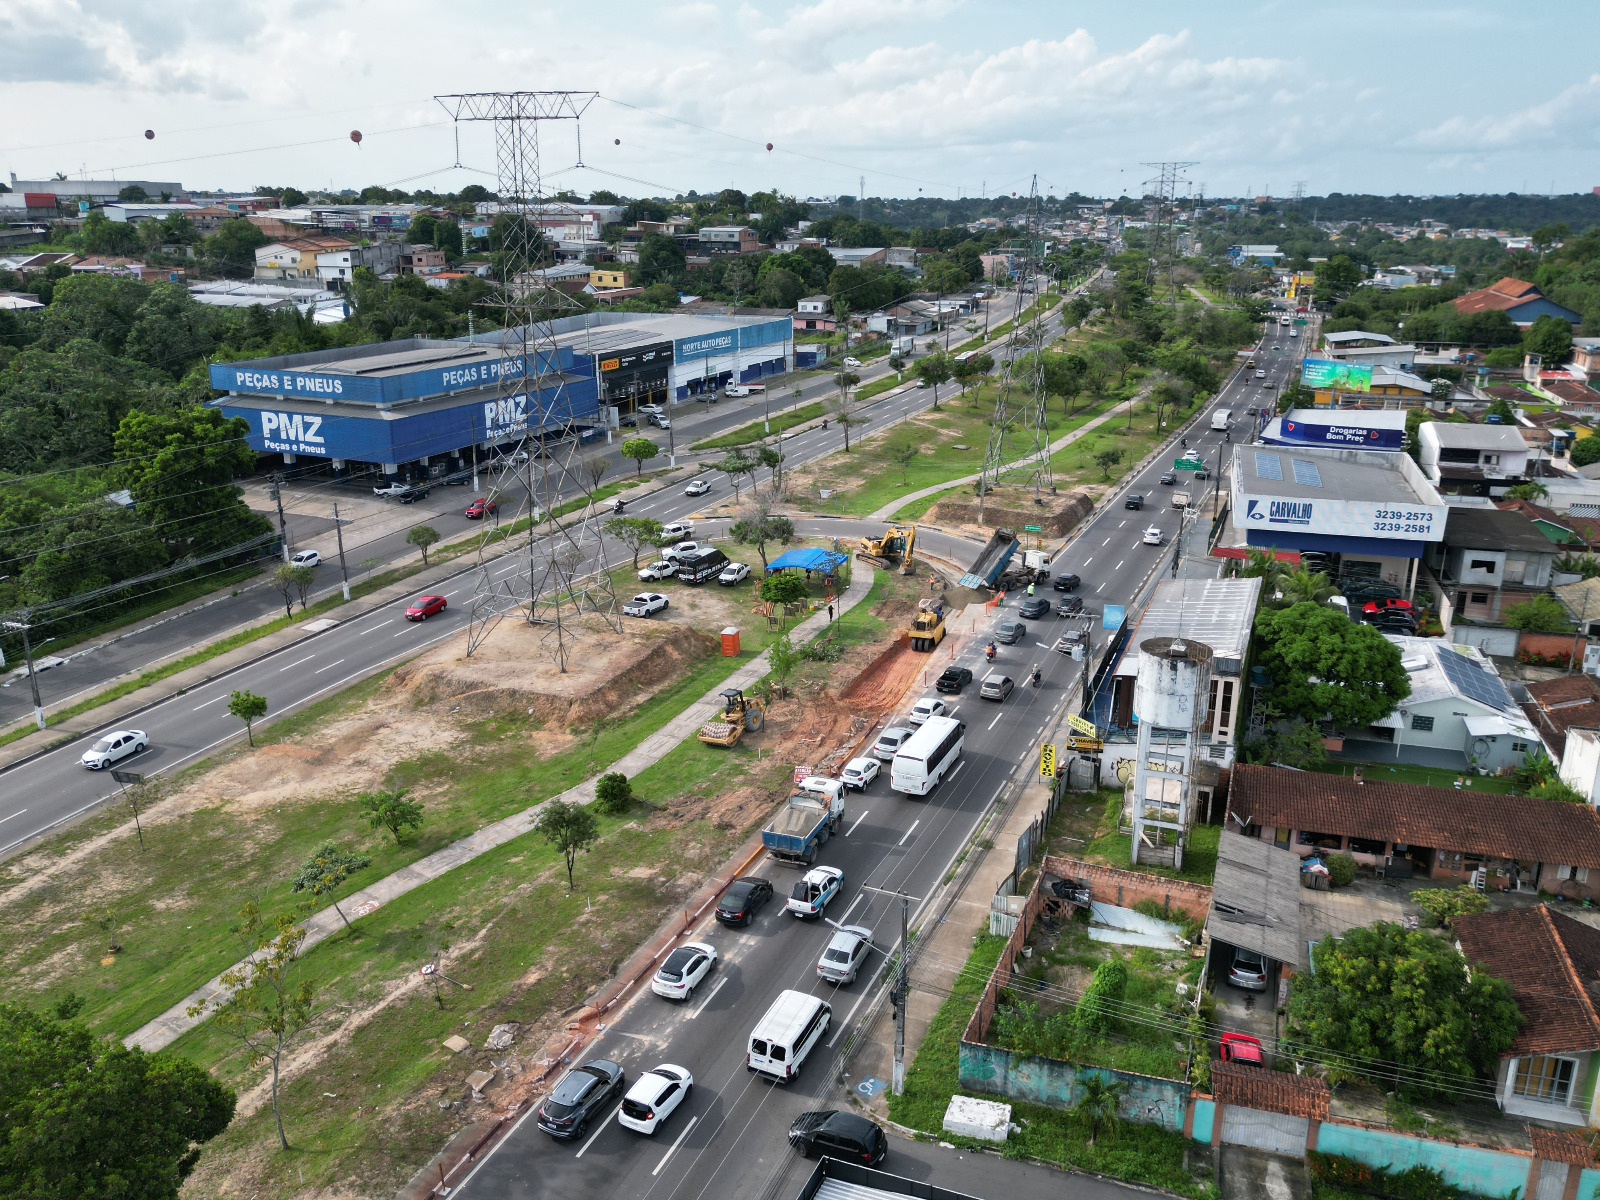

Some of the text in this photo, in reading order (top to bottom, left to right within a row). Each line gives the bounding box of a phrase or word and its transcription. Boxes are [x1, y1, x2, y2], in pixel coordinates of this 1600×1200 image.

[682, 342, 701, 353] NORTE
[442, 359, 523, 387] PEÇAS E PNEUS
[236, 371, 343, 394] PEÇAS E PNEUS
[484, 395, 527, 429] PMZ
[260, 411, 325, 444] PMZ
[1329, 426, 1368, 436] Drogarias
[1326, 432, 1344, 441] Bom
[264, 439, 291, 452] Peças
[299, 443, 326, 454] Pneus
[1269, 501, 1313, 519] CARVALHO
[1375, 509, 1433, 522] 3239-2573
[1373, 522, 1431, 533] 3239-2581
